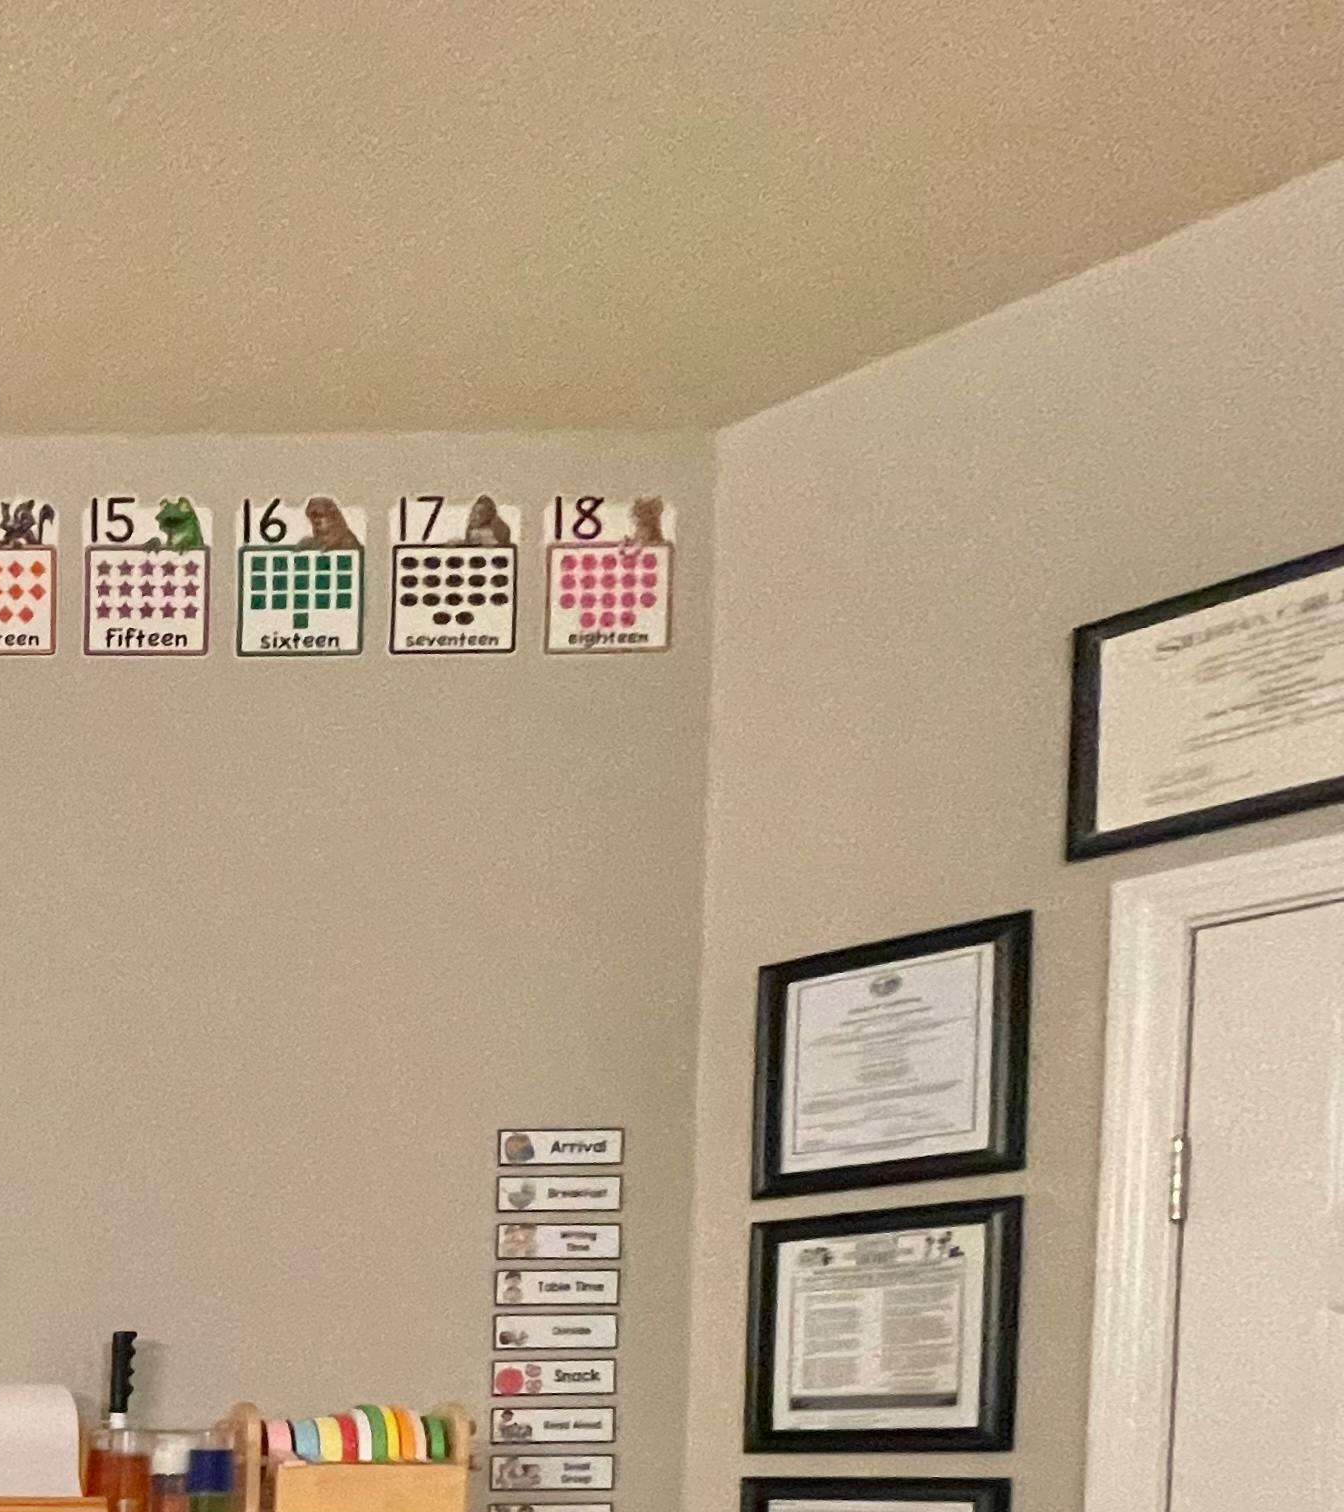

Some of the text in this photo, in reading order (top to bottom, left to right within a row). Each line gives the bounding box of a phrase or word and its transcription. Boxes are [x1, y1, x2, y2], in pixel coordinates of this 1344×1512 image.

[90, 496, 135, 542] 15
[241, 498, 287, 542] 16
[400, 496, 445, 541] 17
[554, 496, 604, 541] 18
[104, 628, 188, 649] fifteen
[260, 630, 341, 652] sixteen
[405, 632, 500, 649] seventeen
[568, 630, 649, 648] eighteen
[551, 1140, 608, 1154] Arrival
[554, 1368, 601, 1383] Snack
